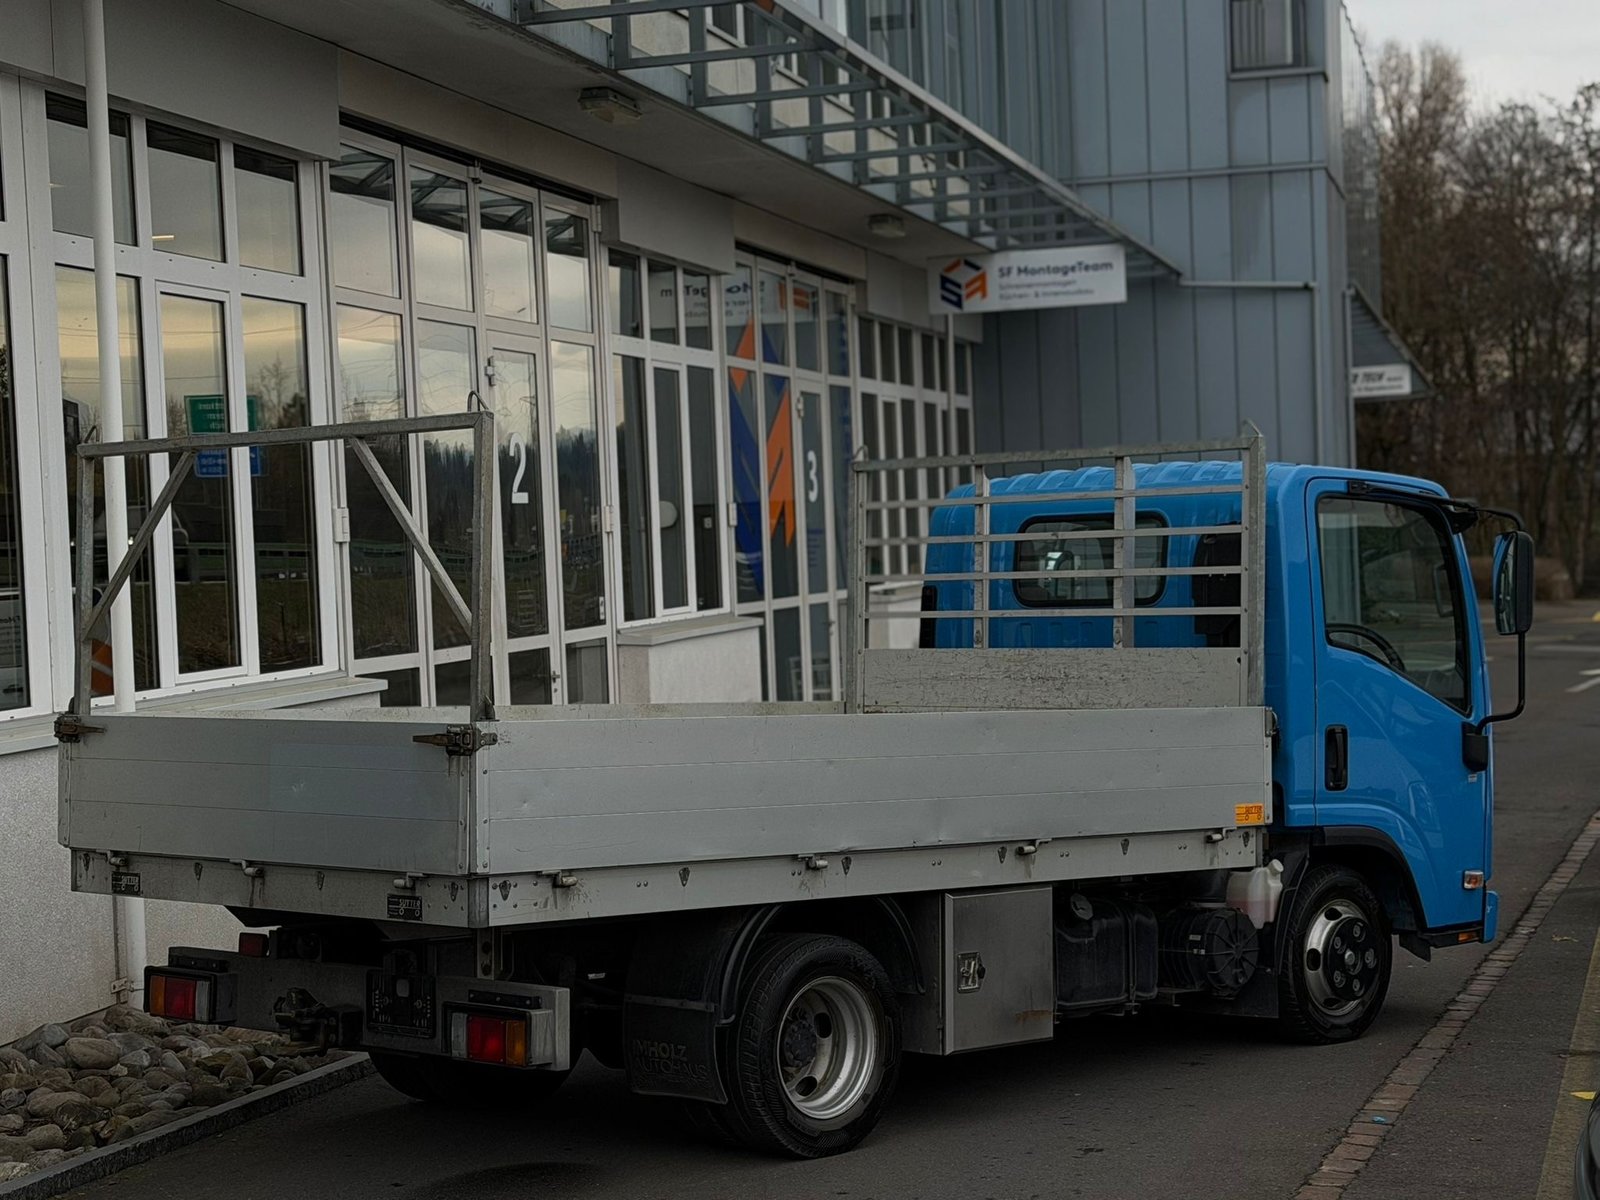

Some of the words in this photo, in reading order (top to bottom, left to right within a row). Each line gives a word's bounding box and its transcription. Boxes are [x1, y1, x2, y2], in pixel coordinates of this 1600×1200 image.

[998, 266, 1013, 279] SF
[1017, 260, 1114, 277] MontageTeam
[509, 432, 529, 504] 2
[807, 450, 819, 503] 3
